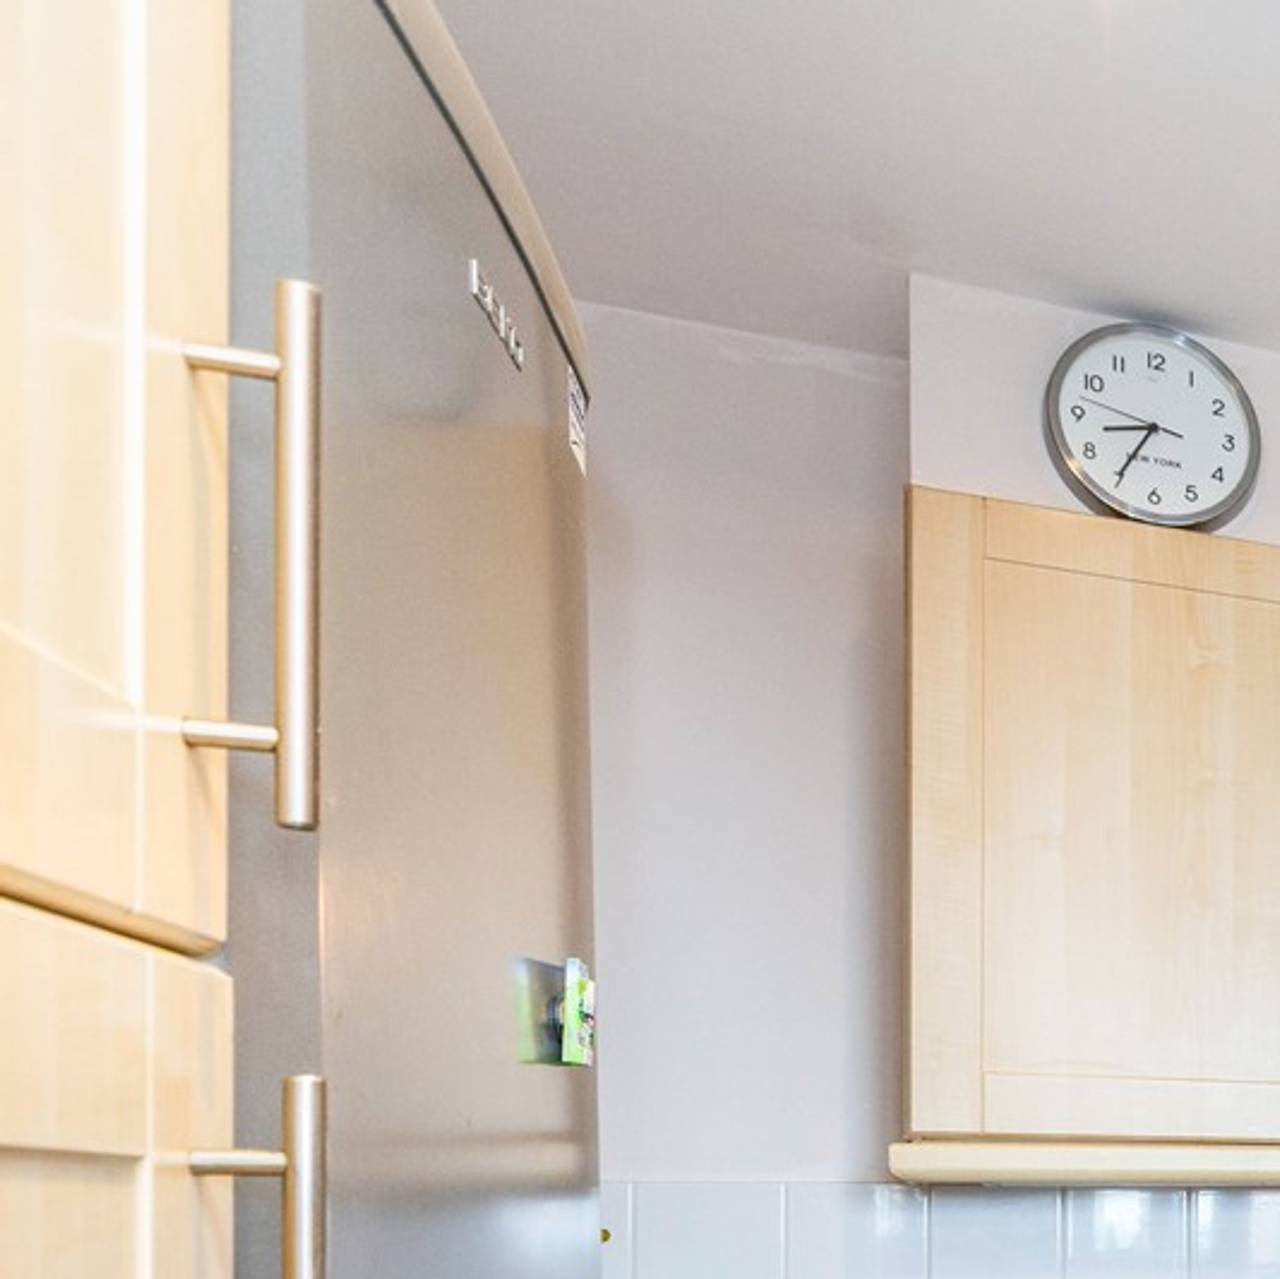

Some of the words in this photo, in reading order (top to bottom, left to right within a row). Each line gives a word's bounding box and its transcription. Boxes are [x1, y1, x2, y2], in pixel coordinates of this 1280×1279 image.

[1112, 355, 1125, 373] 11
[1146, 352, 1166, 372] 12
[1084, 374, 1104, 392] 10
[1070, 405, 1086, 422] 9
[1212, 399, 1225, 417] 2
[1082, 442, 1096, 459] 8
[1221, 435, 1235, 452] 3
[1211, 467, 1224, 482] 4
[1147, 488, 1161, 505] 6
[1184, 485, 1198, 502] 5
